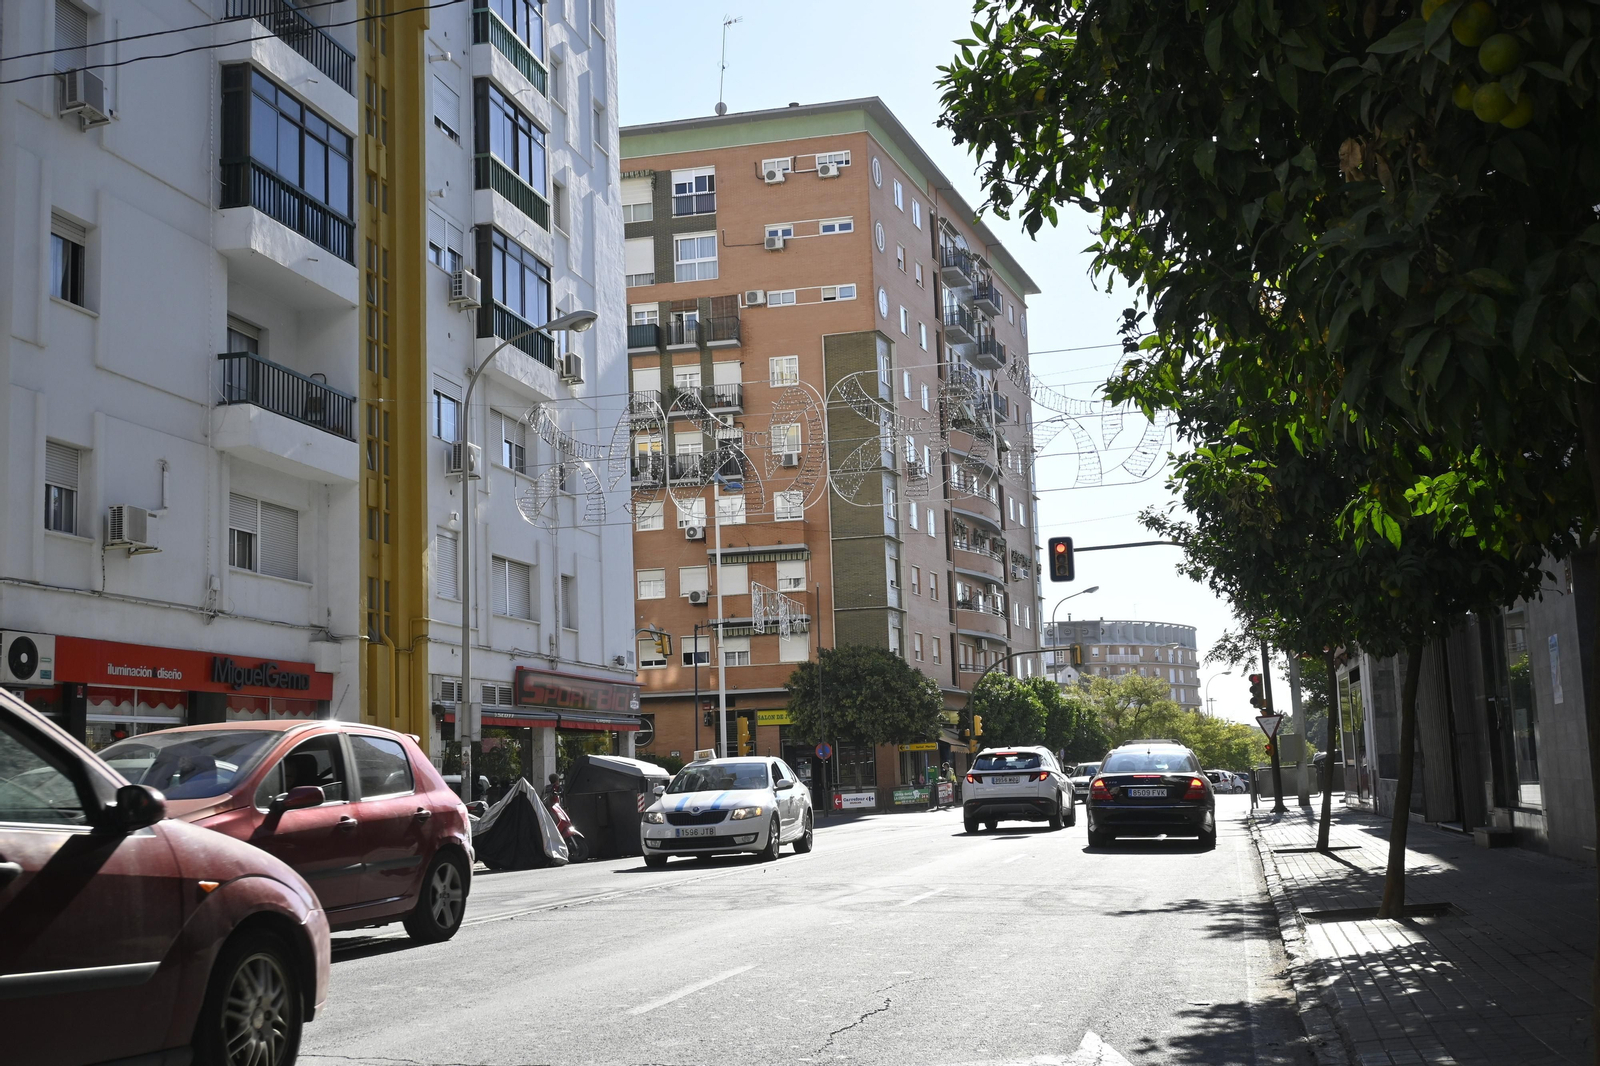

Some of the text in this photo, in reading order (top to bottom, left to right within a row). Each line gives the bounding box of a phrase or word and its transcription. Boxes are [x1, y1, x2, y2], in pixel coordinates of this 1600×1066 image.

[107, 663, 153, 678] iluminación
[157, 667, 182, 680] diseño
[1132, 789, 1167, 798] 8509 FVK
[681, 828, 699, 837] 1596
